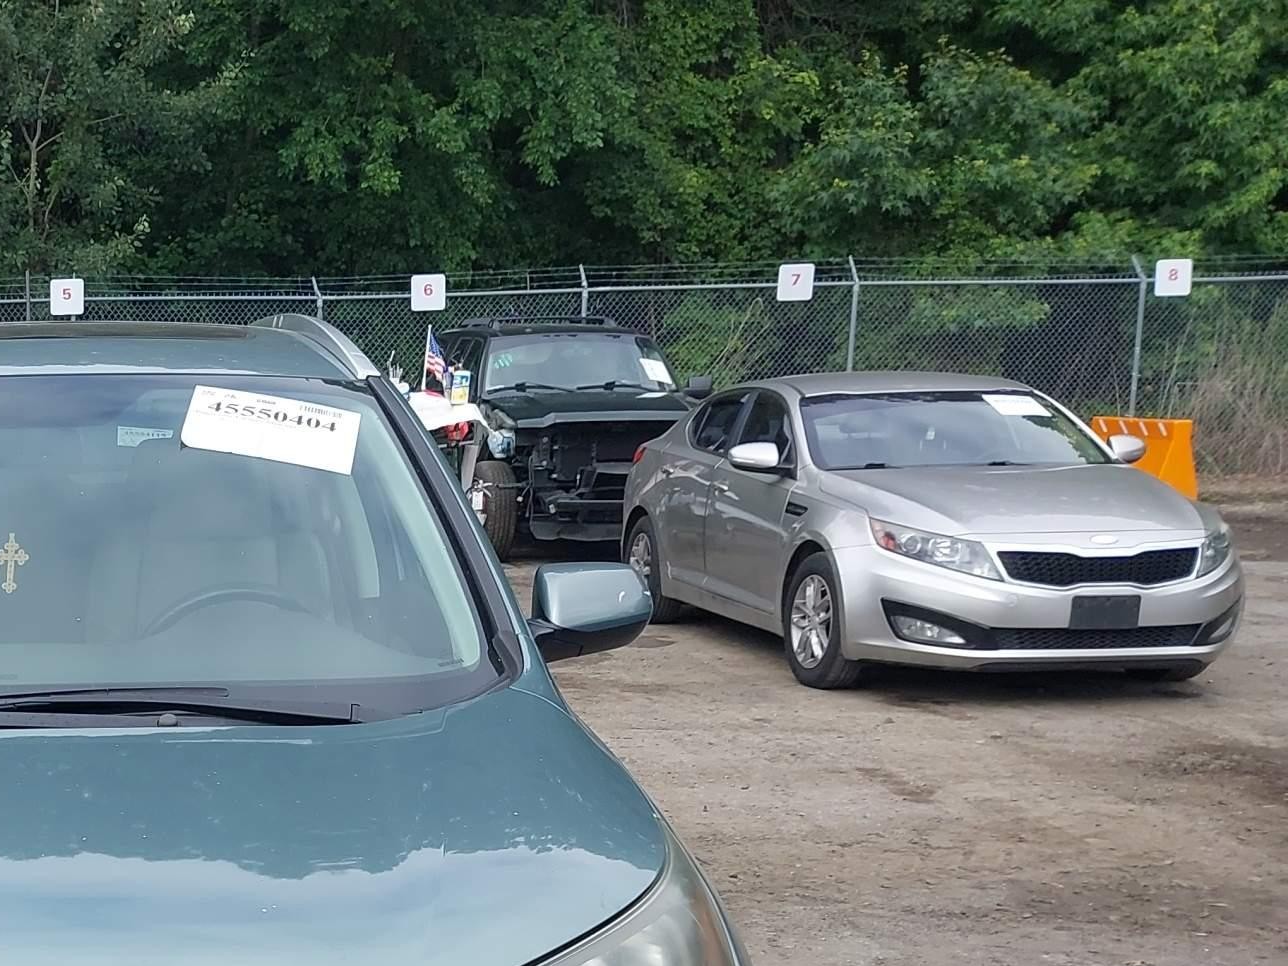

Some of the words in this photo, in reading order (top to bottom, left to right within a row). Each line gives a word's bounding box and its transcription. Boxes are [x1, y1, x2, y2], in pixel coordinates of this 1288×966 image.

[791, 273, 801, 286] 7
[1168, 268, 1179, 281] 8
[62, 288, 72, 300] 5
[423, 283, 433, 296] 6
[208, 401, 337, 432] 45550404
